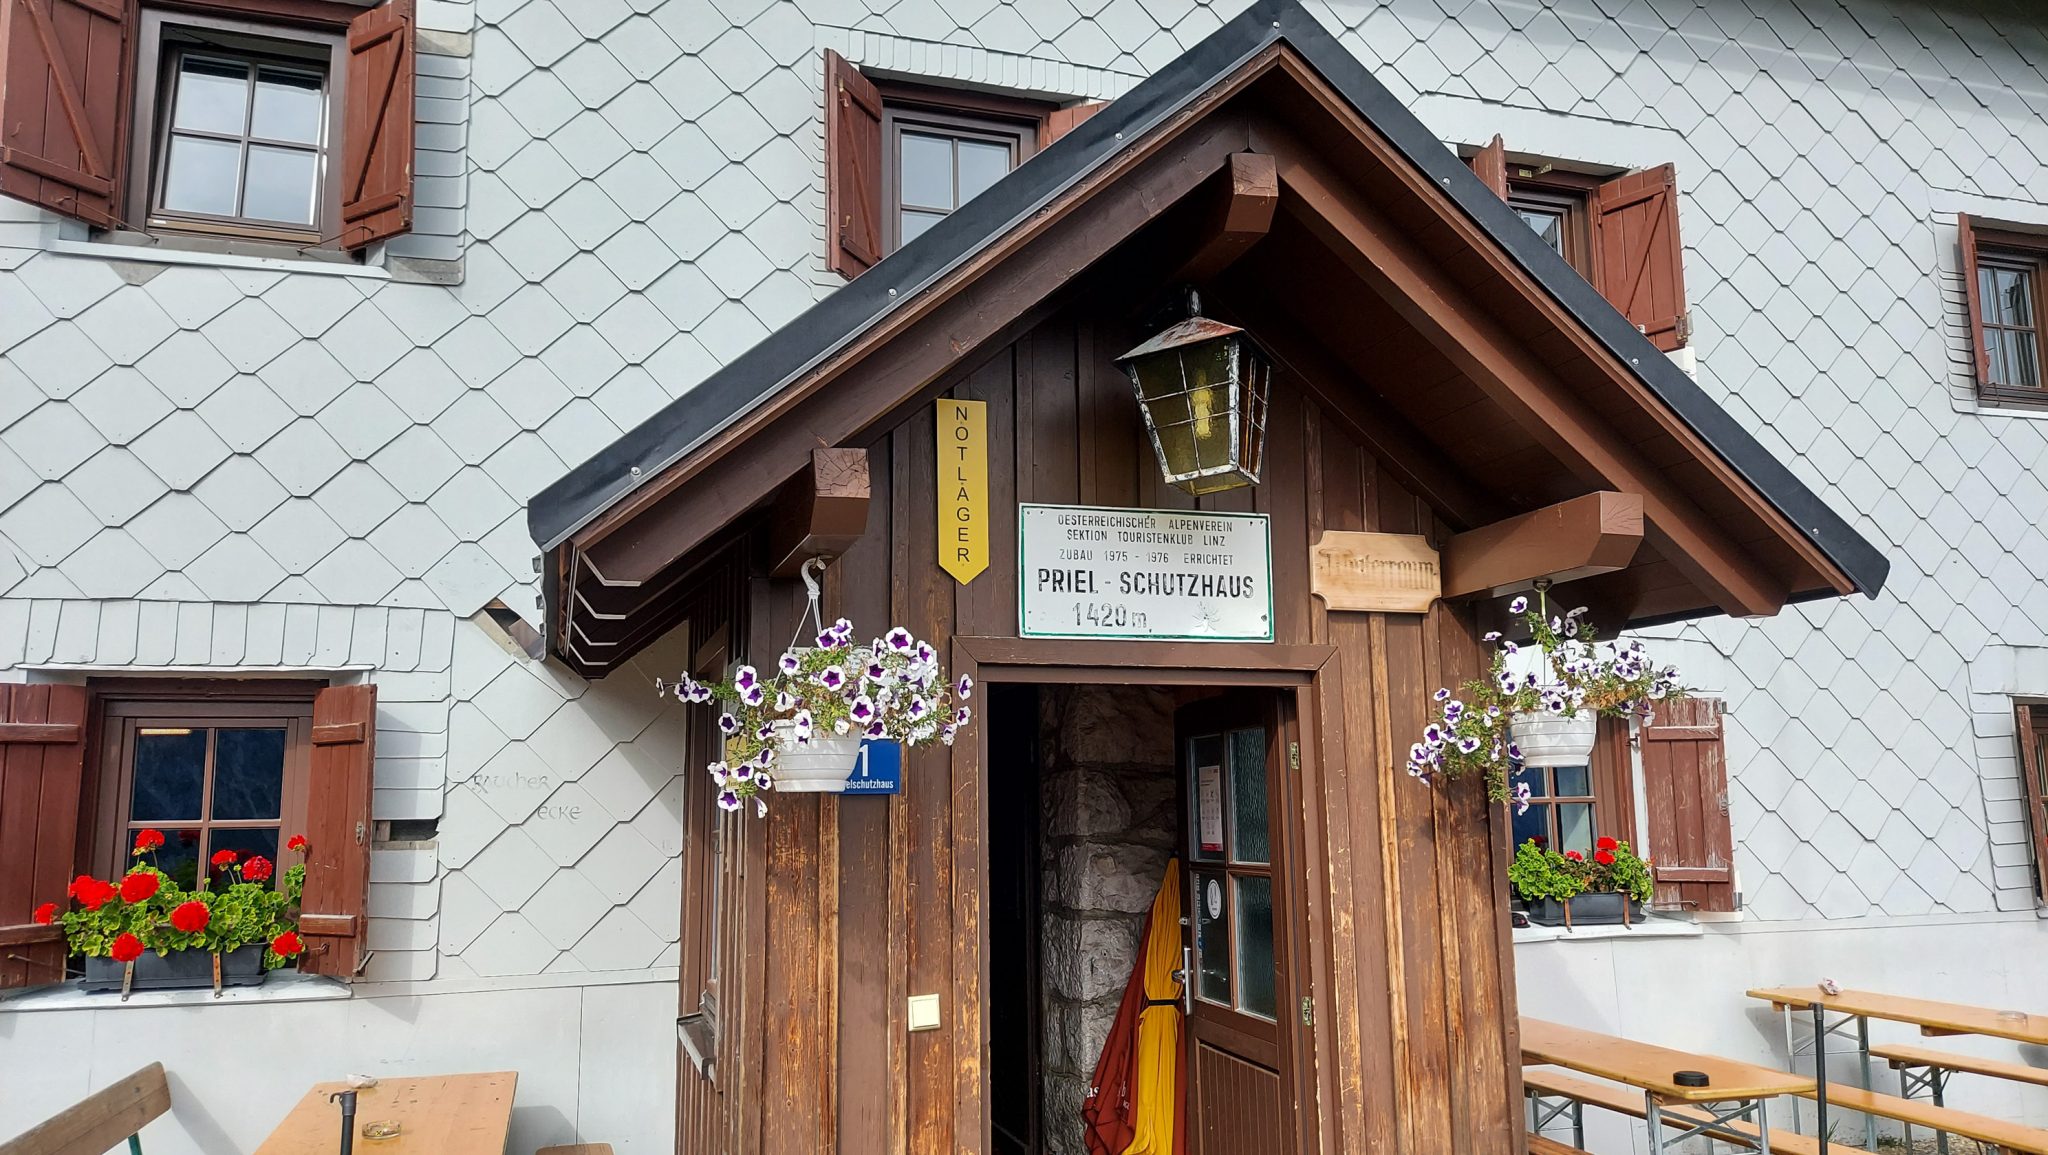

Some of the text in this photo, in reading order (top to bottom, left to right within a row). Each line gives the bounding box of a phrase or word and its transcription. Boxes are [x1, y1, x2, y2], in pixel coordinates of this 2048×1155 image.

[955, 406, 970, 562] NOTLAGER
[1058, 514, 1233, 532] OESTERREICHISCHER ALPENVEREIN
[1067, 529, 1226, 546] SEKTION TOURISTENKLUB LINZ
[1059, 548, 1093, 561] ZUBAU
[1104, 550, 1128, 562] 1975
[1147, 552, 1169, 563] 1976
[1183, 552, 1234, 566] ERRICHTET
[1038, 568, 1099, 594] PRIEL
[1119, 571, 1254, 599] SCHUTZHAUS
[846, 779, 893, 789] elschutzhaus
